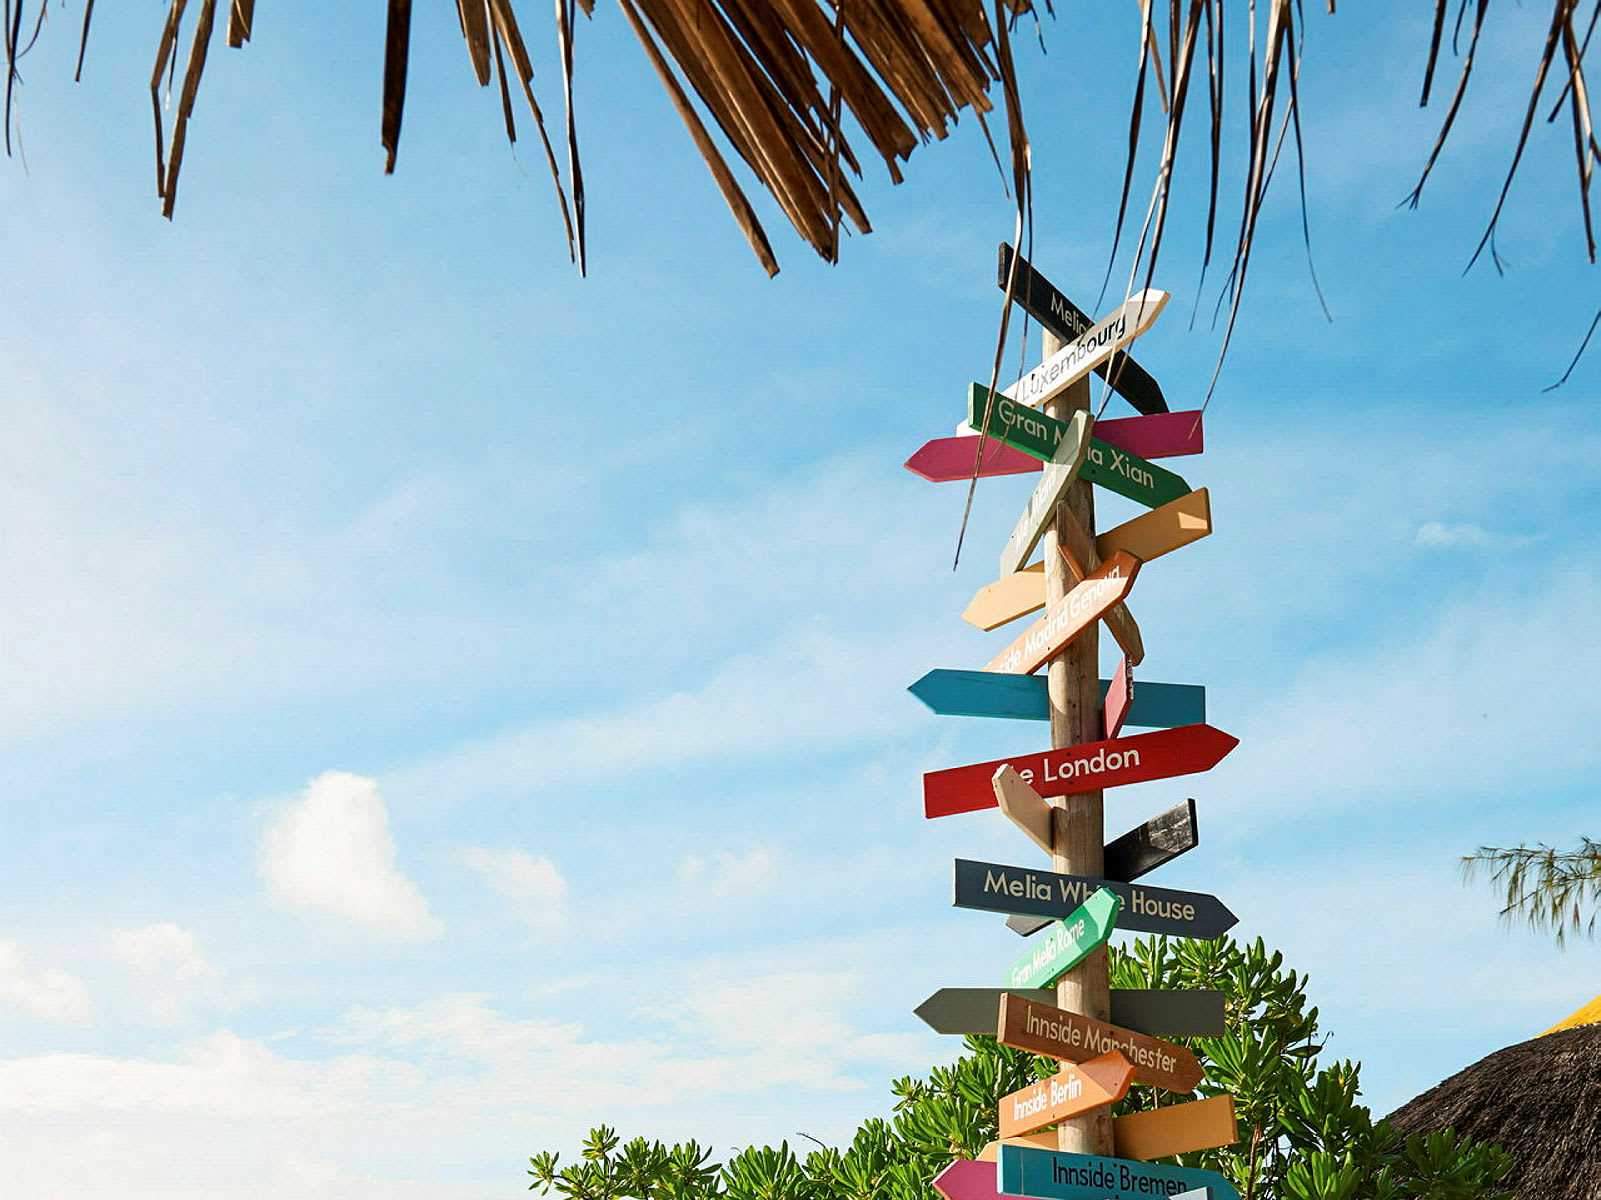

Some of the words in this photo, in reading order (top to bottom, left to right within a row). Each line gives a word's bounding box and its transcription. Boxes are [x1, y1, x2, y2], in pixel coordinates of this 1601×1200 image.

[999, 399, 1047, 440] Gran
[1109, 449, 1154, 489] Xian
[1024, 601, 1068, 658] Madrid
[1044, 748, 1140, 783] London
[983, 870, 1051, 900] Melia
[1132, 891, 1195, 921] House
[1056, 919, 1085, 954] Rome
[1026, 1005, 1080, 1047] Innside
[1013, 1086, 1047, 1120] Innside
[1050, 1074, 1082, 1107] Berlin
[1053, 1156, 1115, 1188] Innside
[1120, 1164, 1187, 1195] Bremen
